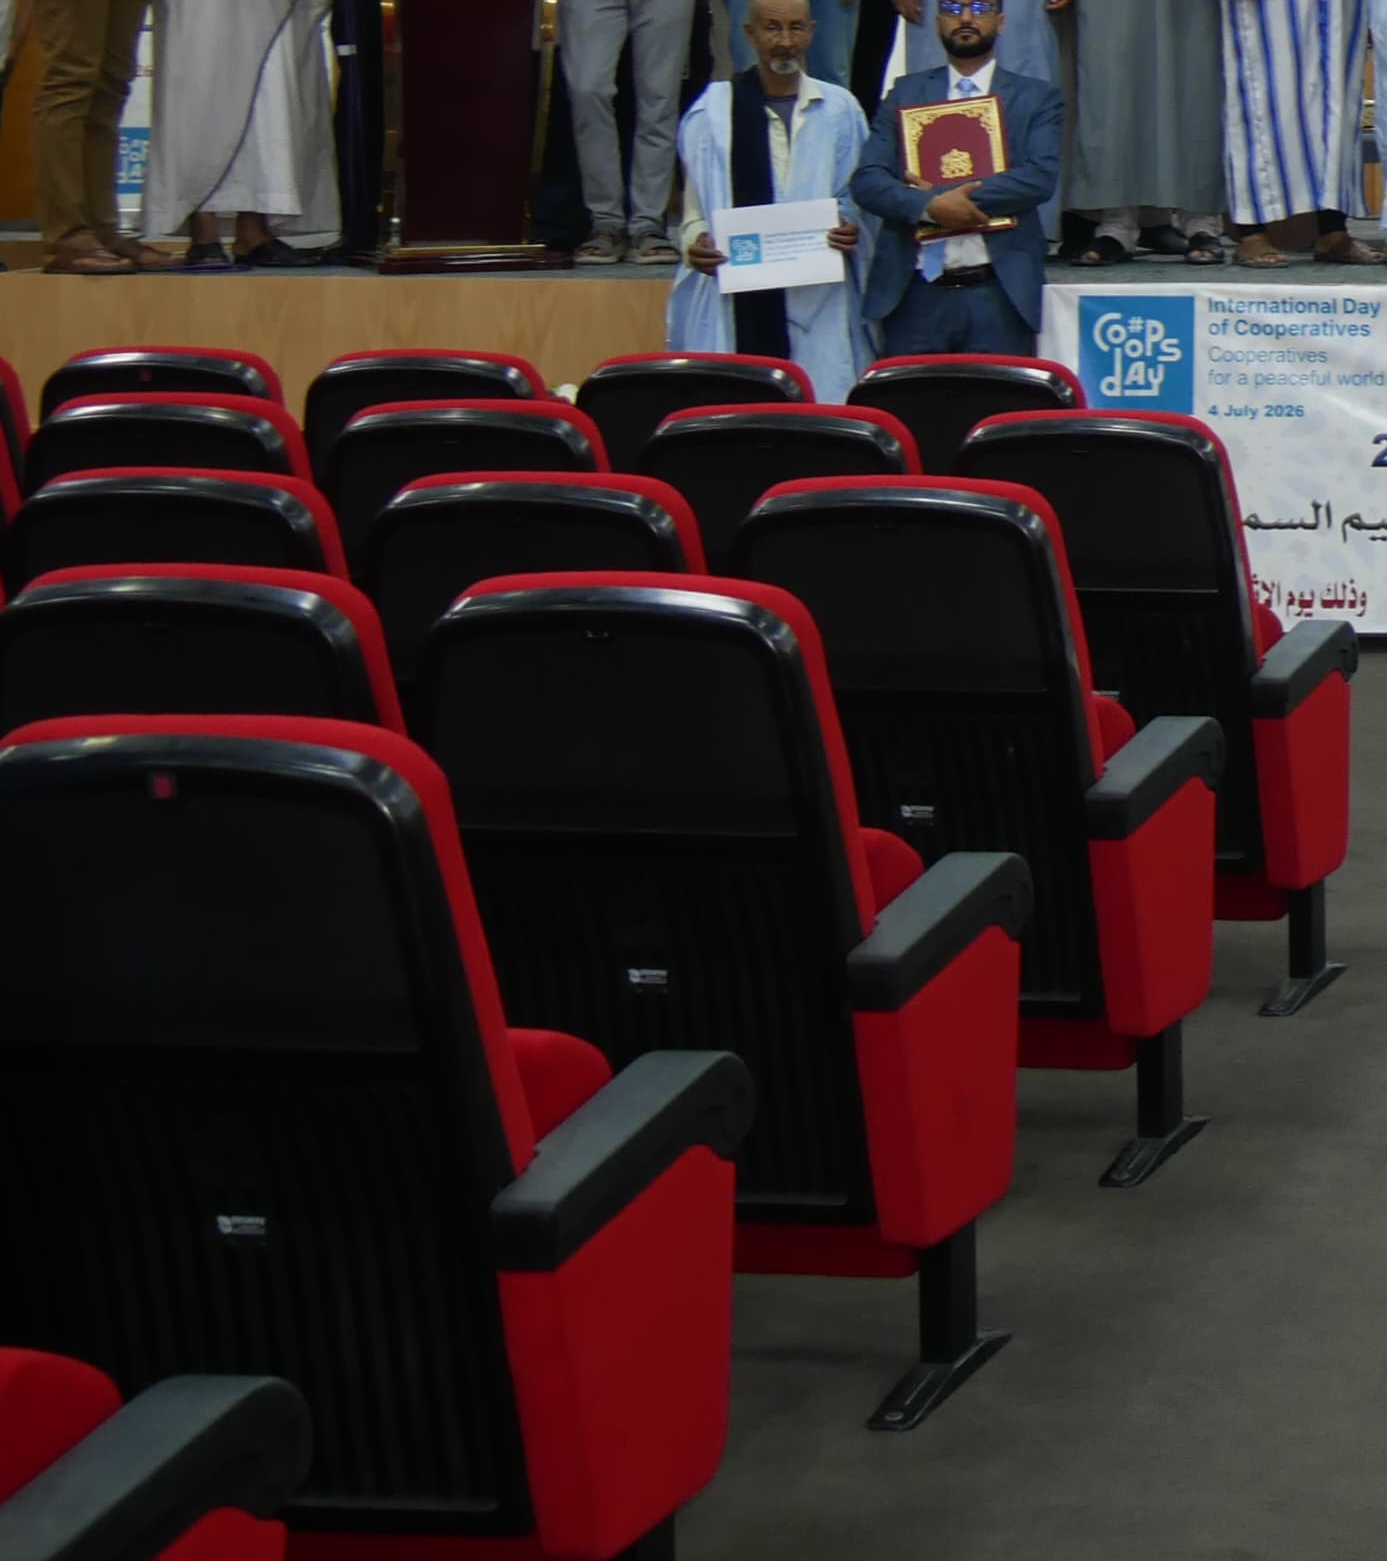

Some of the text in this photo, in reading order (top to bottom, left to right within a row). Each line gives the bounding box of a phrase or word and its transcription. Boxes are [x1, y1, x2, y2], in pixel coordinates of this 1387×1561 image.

[1208, 297, 1381, 318] International Day
[1208, 319, 1371, 340] of Cooperatives
[1208, 346, 1329, 365] Cooperatives
[1208, 369, 1385, 390] for a peaceful world
[1207, 404, 1306, 421] 4 July 2026
[1243, 499, 1333, 532] السم
[1285, 588, 1316, 619] يوم
[1319, 577, 1369, 618] وذلك
